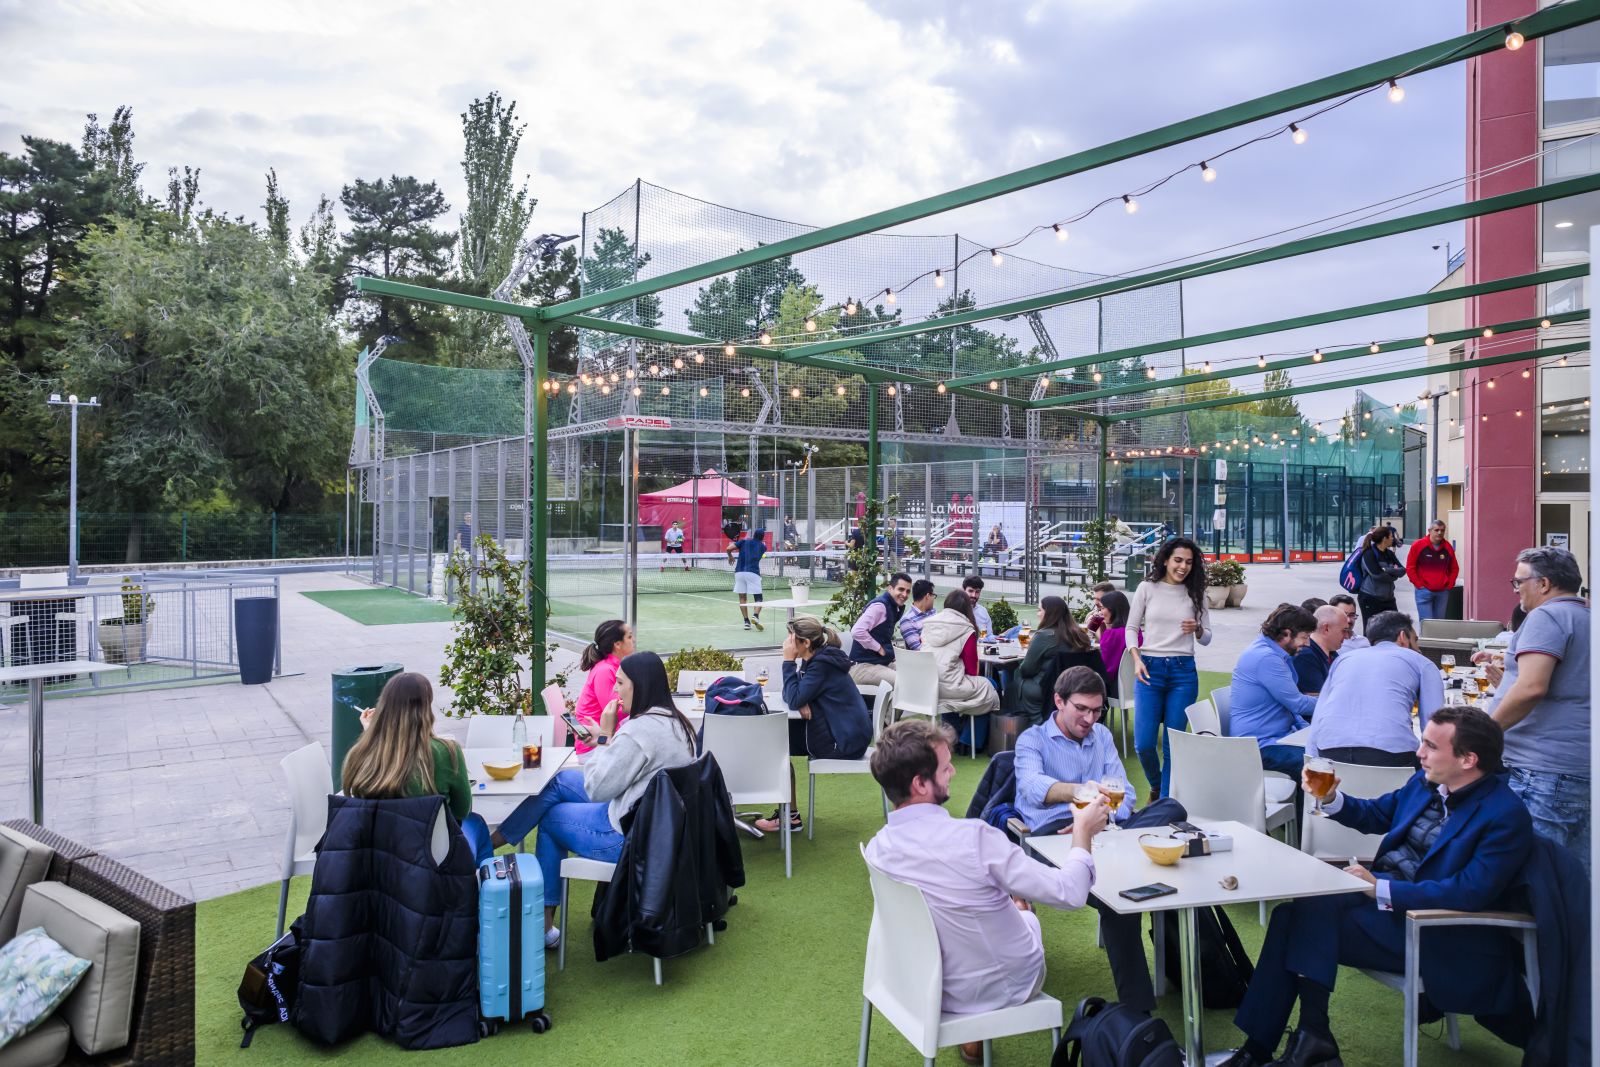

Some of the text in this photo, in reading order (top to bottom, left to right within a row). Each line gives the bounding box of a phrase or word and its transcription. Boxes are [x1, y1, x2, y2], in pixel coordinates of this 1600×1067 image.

[625, 417, 670, 426] PADEL
[931, 502, 980, 514] La Moral
